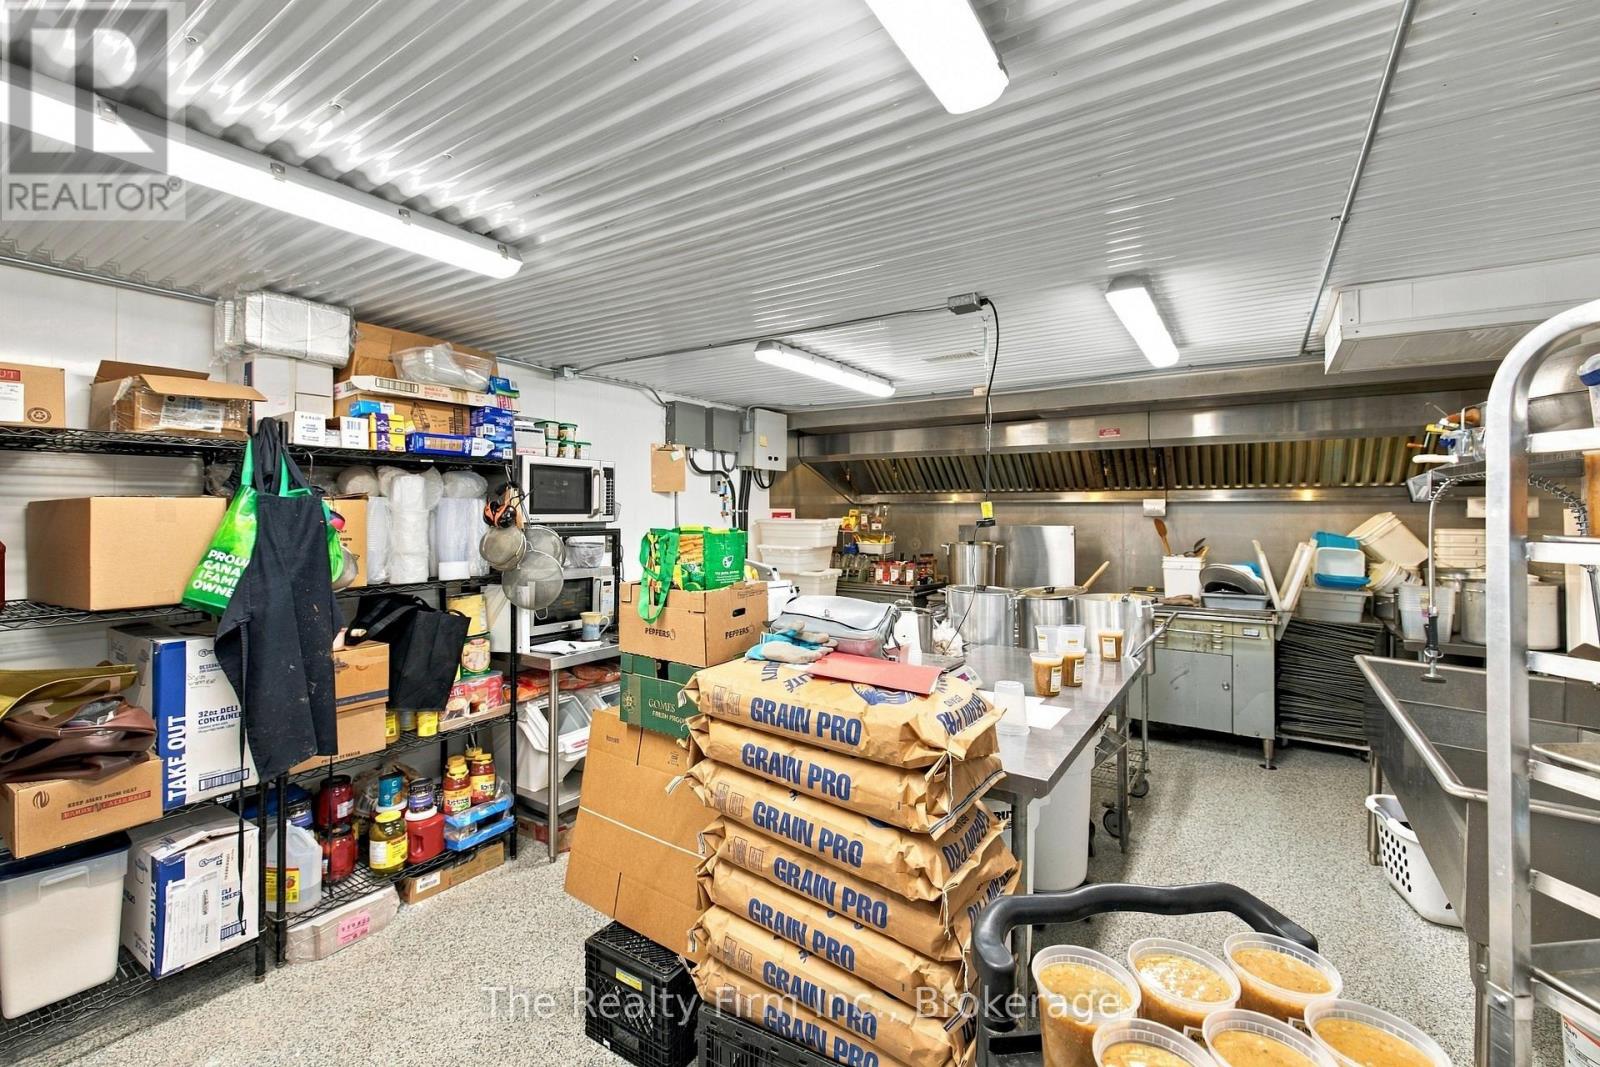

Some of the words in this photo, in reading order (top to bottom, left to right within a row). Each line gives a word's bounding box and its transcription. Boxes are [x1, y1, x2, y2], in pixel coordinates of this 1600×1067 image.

[168, 716, 187, 751] OUT
[750, 697, 814, 735] GRAIN
[816, 711, 863, 747] PRO
[168, 753, 187, 802] TAKE
[742, 743, 804, 786] GRAIN
[807, 765, 852, 801] PRO
[752, 801, 815, 848] GRAIN
[819, 827, 864, 868] PRO
[774, 857, 836, 907] GRAIN
[841, 887, 888, 929] PRO
[748, 898, 807, 949] GRAIN
[812, 930, 855, 972] PRO
[763, 961, 827, 1015] GRAIN
[831, 996, 878, 1040] PRO
[764, 1005, 828, 1052] GRAIN
[831, 1036, 880, 1067] PRO
